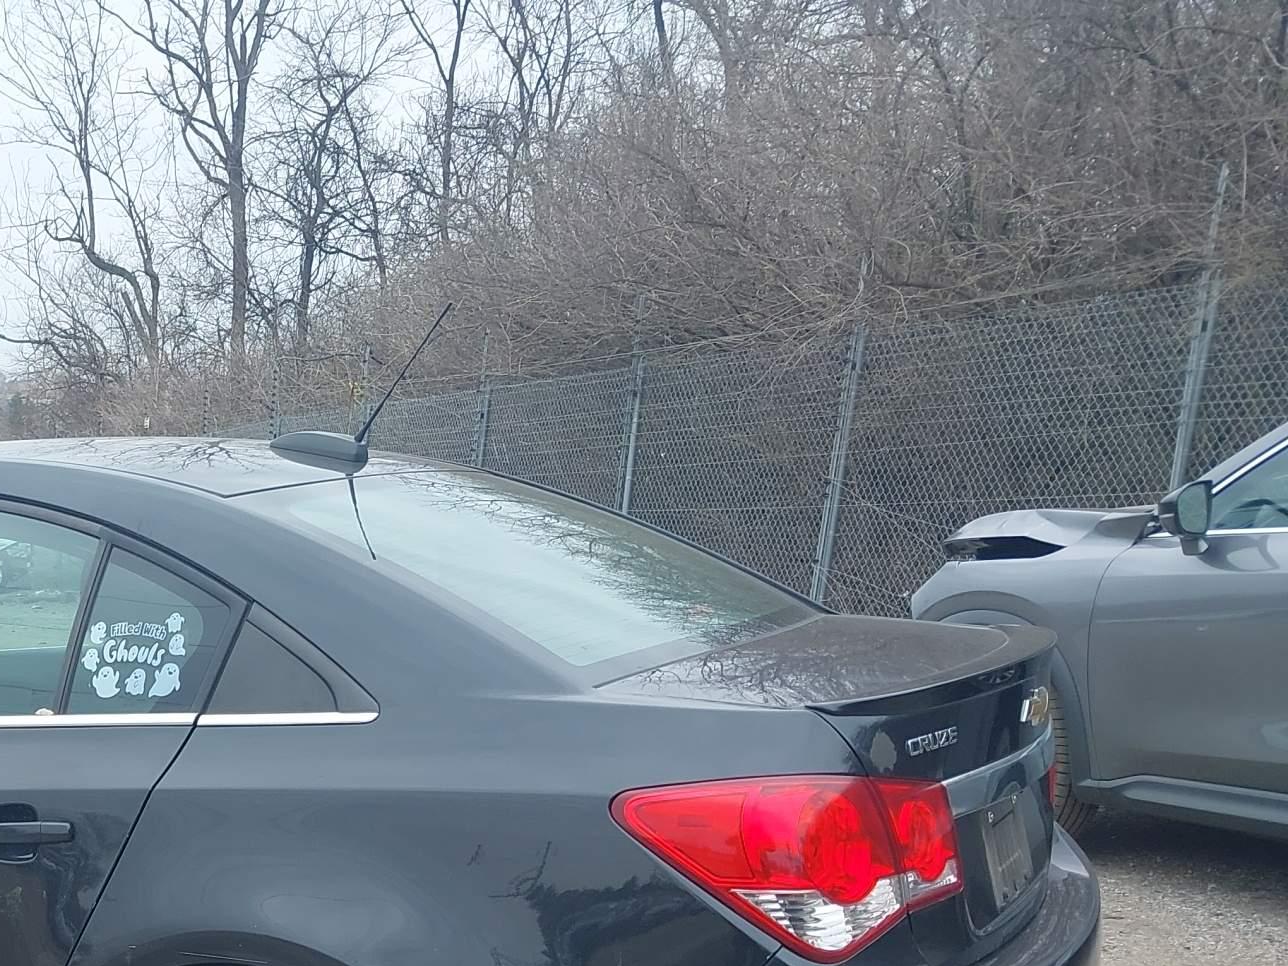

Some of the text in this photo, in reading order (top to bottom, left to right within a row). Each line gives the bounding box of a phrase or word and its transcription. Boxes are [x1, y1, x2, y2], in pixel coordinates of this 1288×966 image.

[110, 622, 167, 641] Filled With
[103, 639, 166, 667] Ghouls
[906, 726, 959, 758] CRUZE
